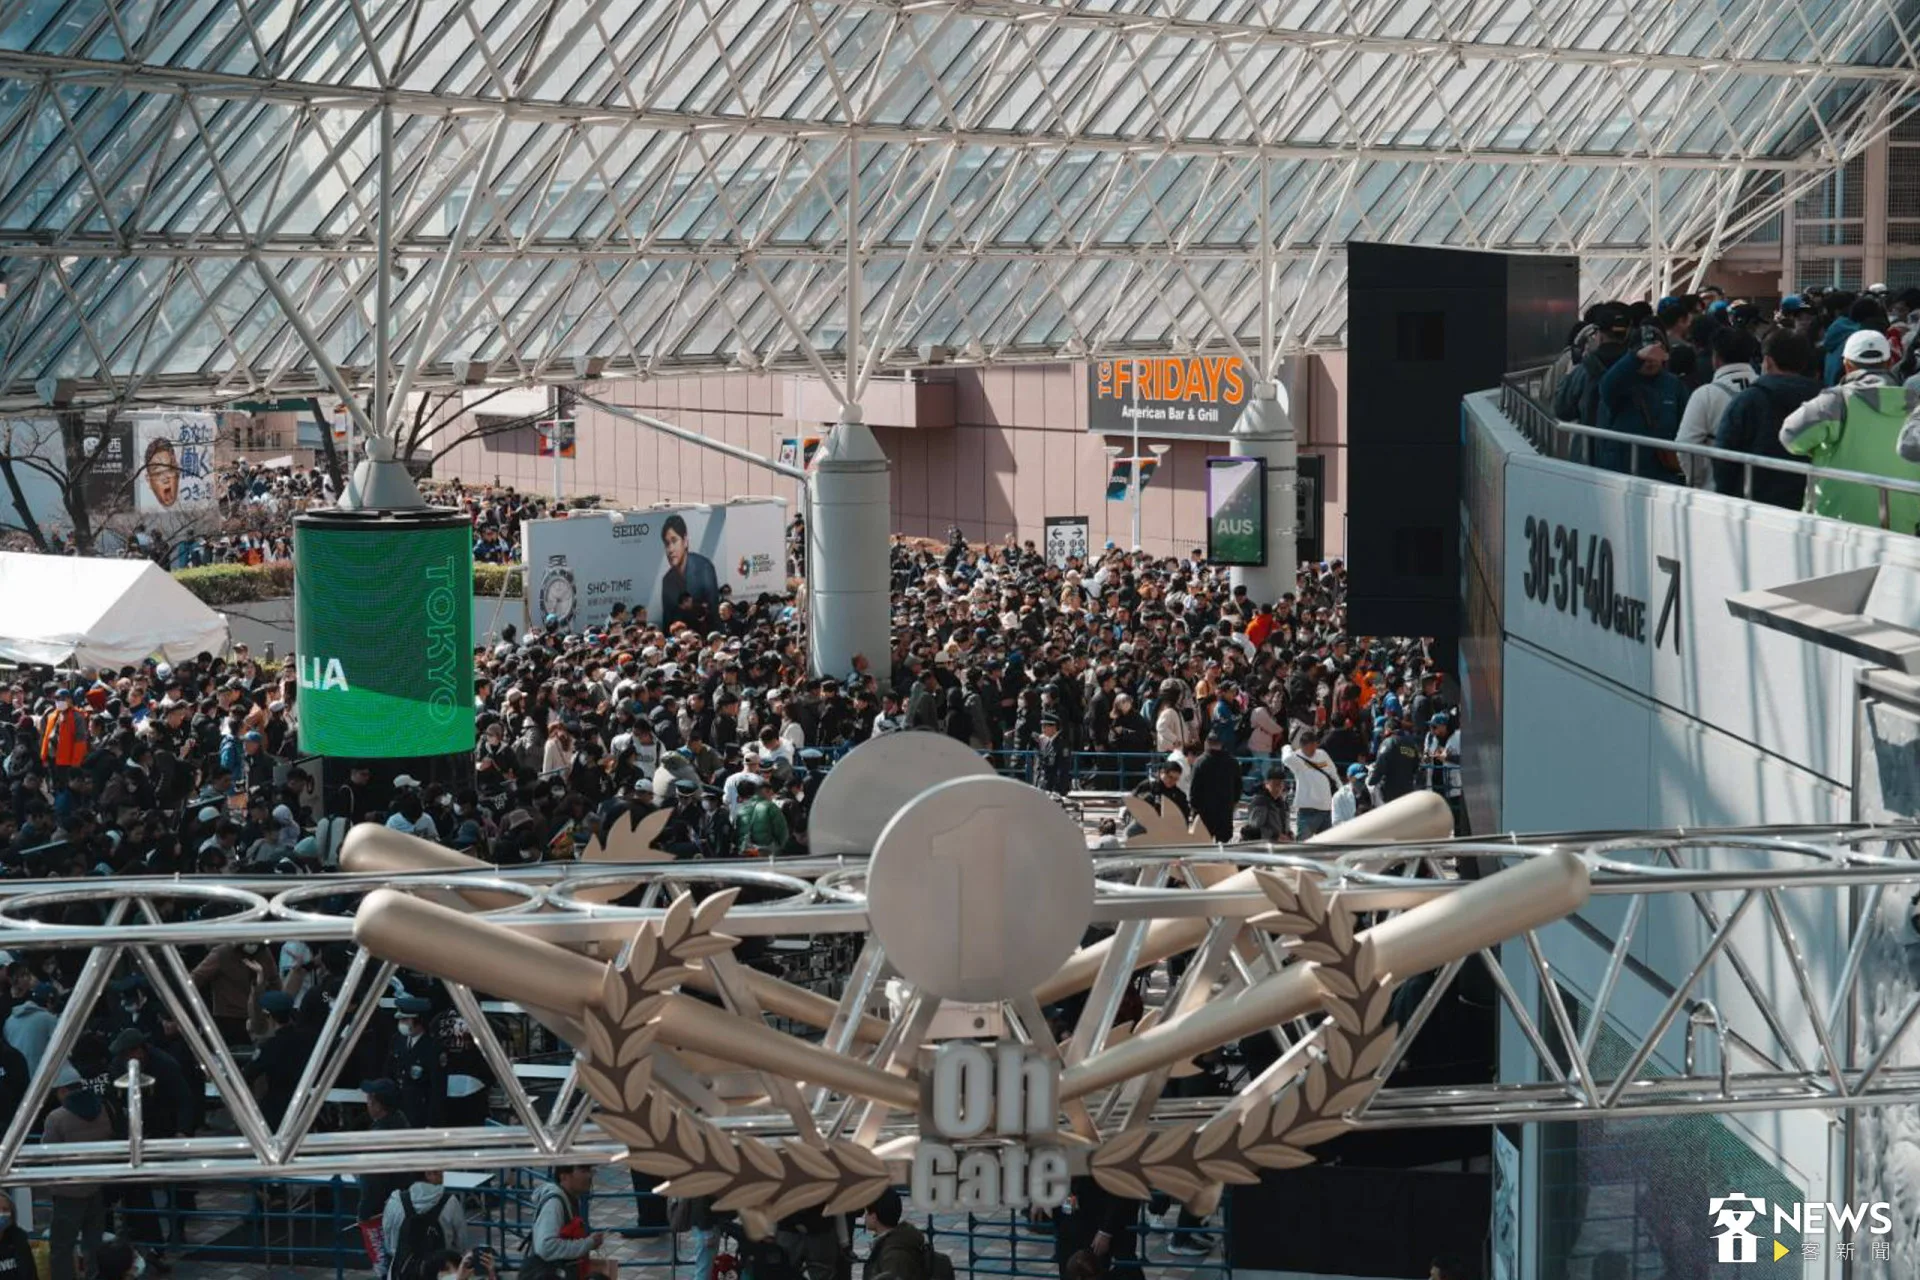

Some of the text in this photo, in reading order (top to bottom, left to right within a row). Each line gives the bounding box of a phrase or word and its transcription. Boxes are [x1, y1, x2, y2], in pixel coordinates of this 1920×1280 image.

[1098, 356, 1244, 405] TG FRIDAYS
[1121, 405, 1219, 422] American Bar & Grill
[612, 523, 649, 538] SEIKO
[1217, 519, 1254, 535] AUS
[426, 556, 457, 724] TOKYO
[1614, 593, 1646, 645] GATE
[933, 1040, 1053, 1138] Oh
[911, 1142, 1071, 1212] Gate
